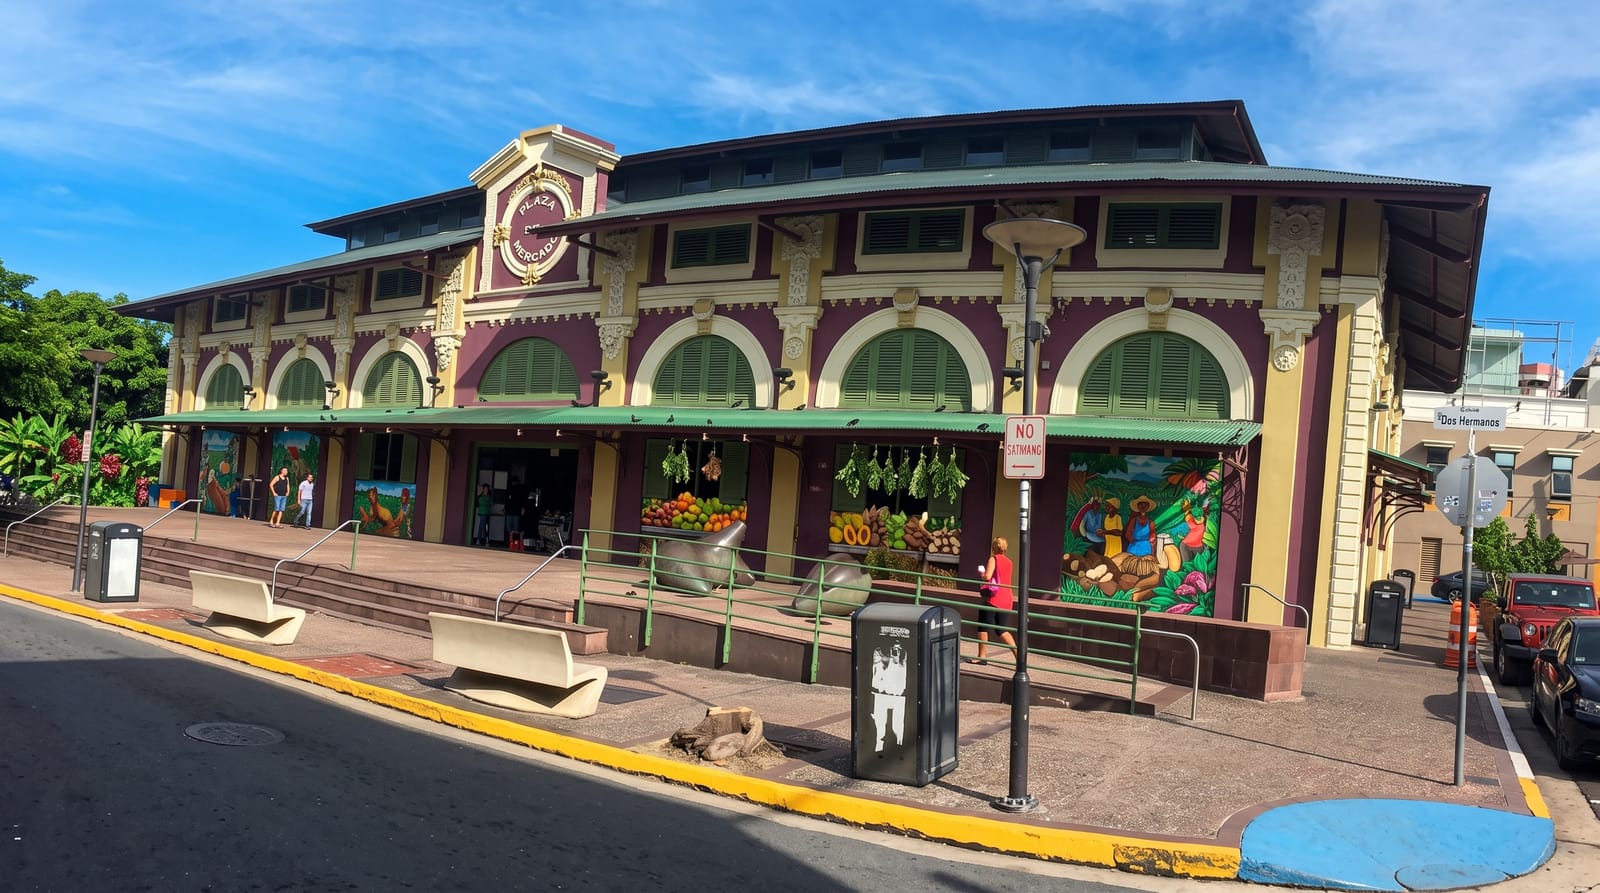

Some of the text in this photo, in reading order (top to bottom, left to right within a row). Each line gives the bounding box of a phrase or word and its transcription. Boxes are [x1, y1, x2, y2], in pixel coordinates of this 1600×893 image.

[519, 195, 555, 215] PLAZA
[524, 223, 541, 235] D
[513, 236, 558, 262] MERCADO
[1441, 414, 1456, 425] Dos
[1459, 415, 1500, 427] Hermanos
[1016, 423, 1034, 438] NO
